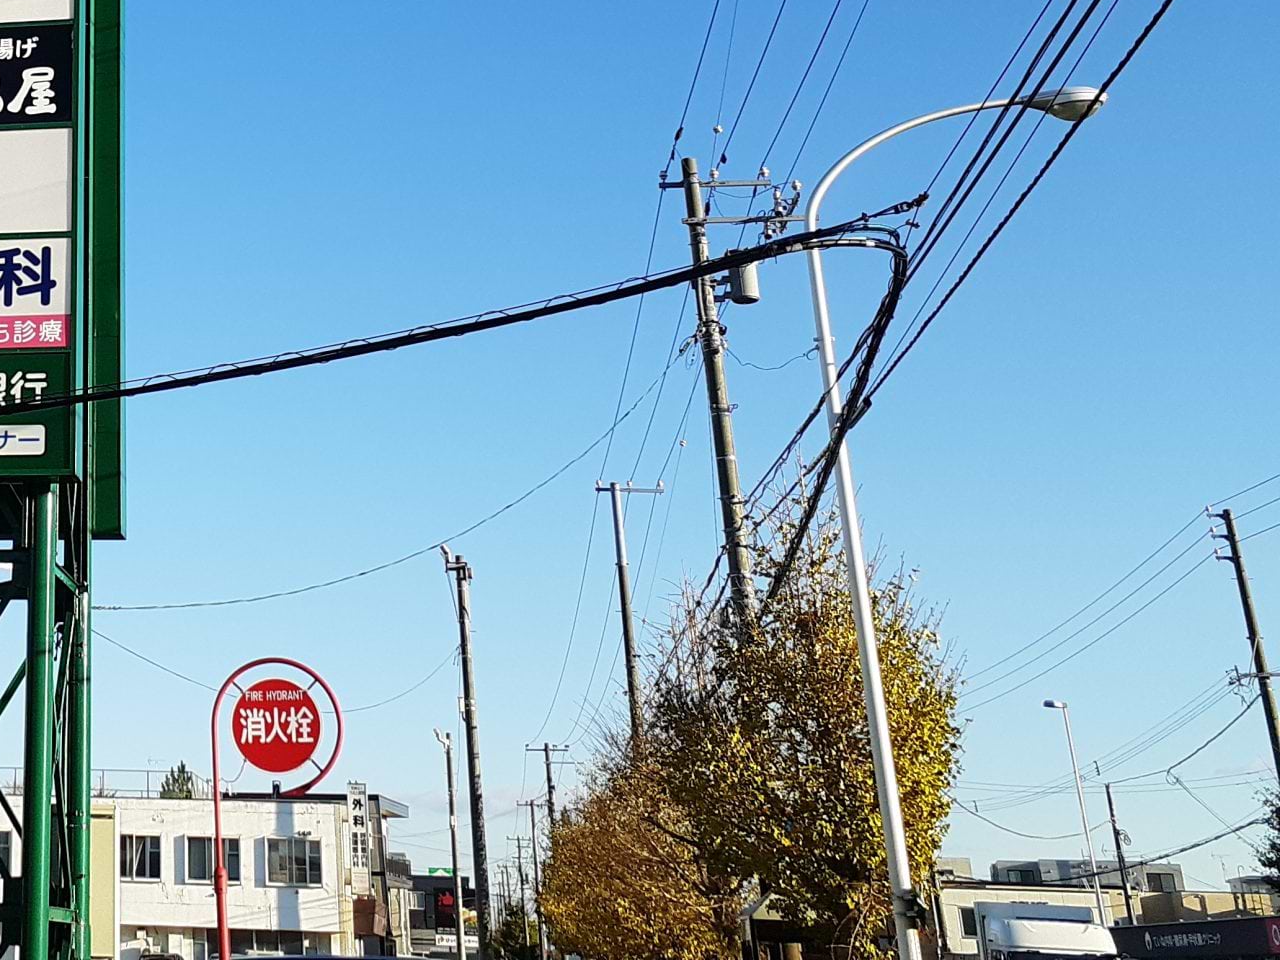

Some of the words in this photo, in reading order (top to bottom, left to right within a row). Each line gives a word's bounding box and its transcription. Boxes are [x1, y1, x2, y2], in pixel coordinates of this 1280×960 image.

[245, 690, 264, 701] FIRE
[266, 689, 304, 701] HYDRANT
[239, 705, 315, 744] 消火栓
[351, 798, 365, 828] 外科
